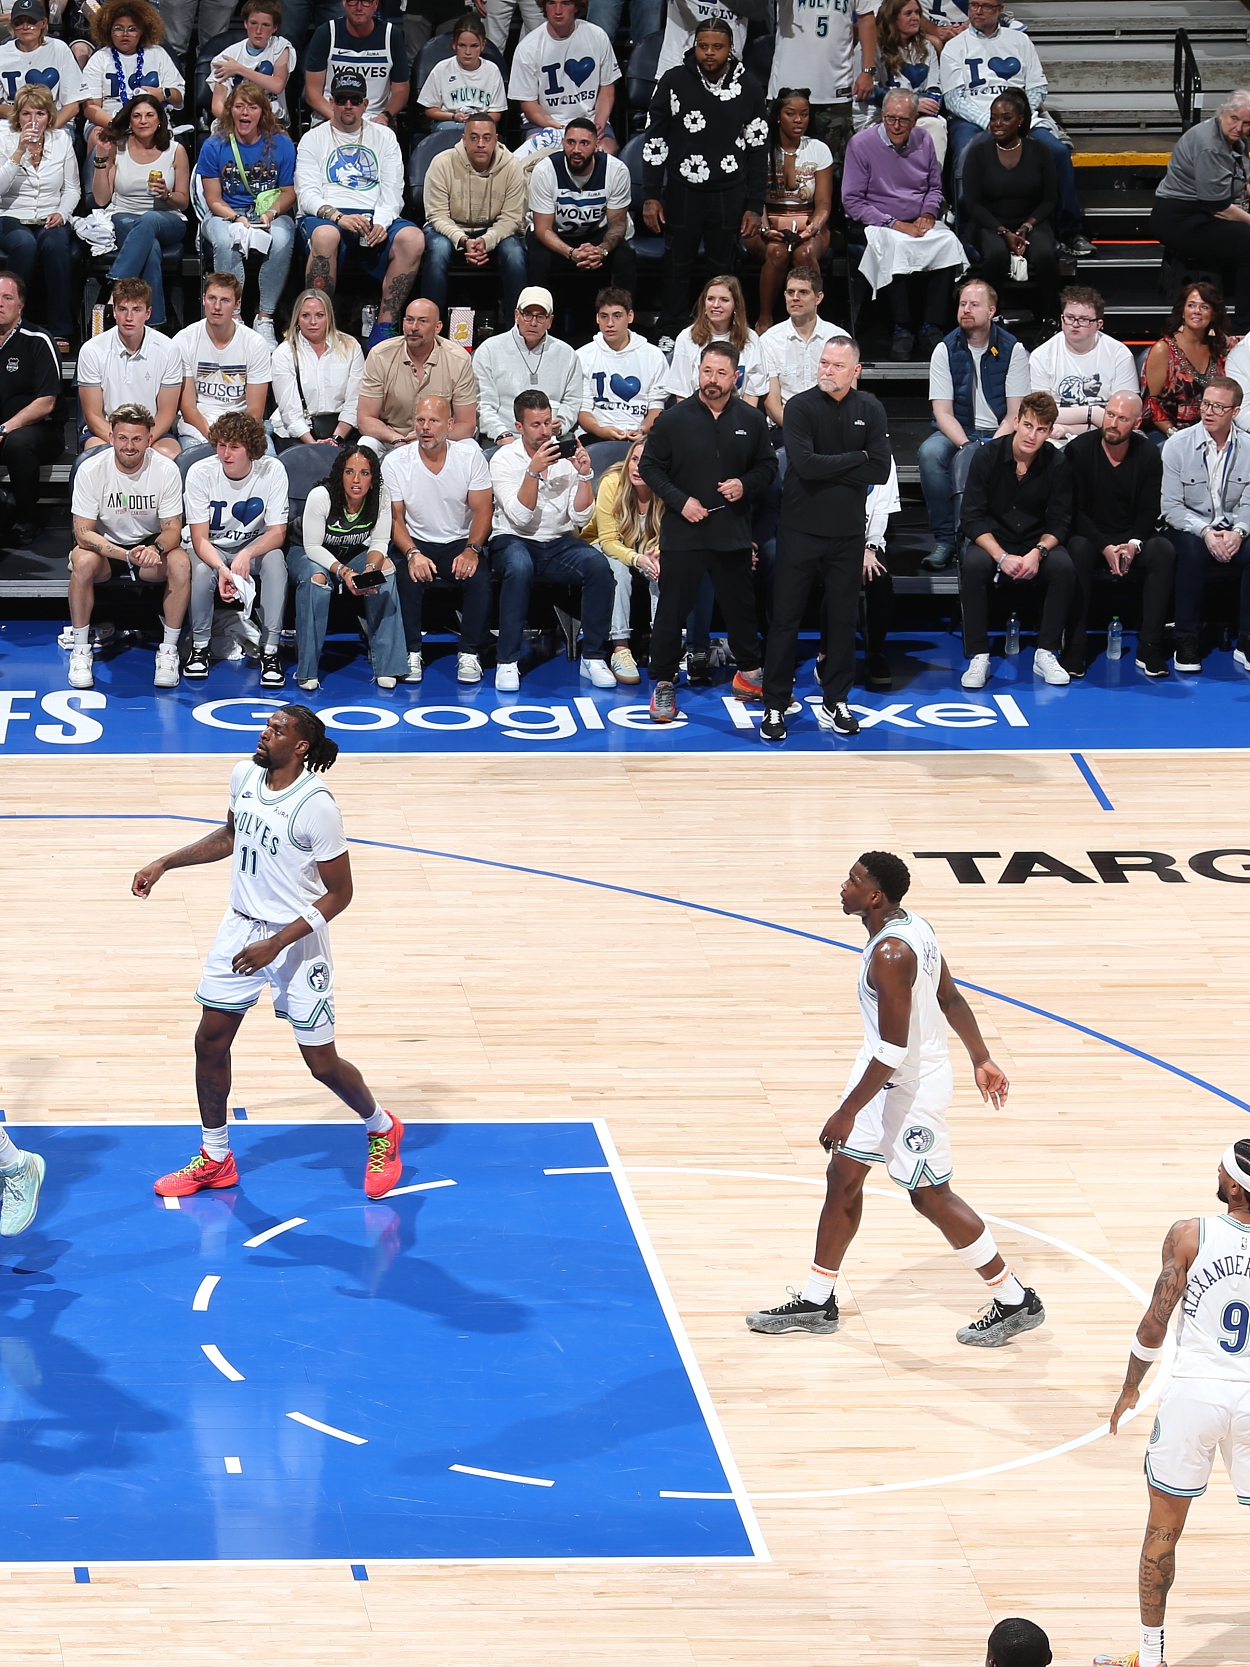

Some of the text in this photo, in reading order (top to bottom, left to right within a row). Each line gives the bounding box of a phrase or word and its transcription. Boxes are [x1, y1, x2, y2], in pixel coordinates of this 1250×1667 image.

[816, 15, 829, 38] 5
[541, 63, 565, 95] I
[965, 58, 987, 88] I
[450, 86, 491, 107] WOLVES
[546, 90, 596, 107] WOLVES
[198, 381, 246, 398] BUSCH
[592, 371, 609, 402] I
[210, 500, 228, 530] I
[192, 696, 689, 740] Google
[239, 844, 258, 878] 11
[1217, 1299, 1250, 1356] 9
